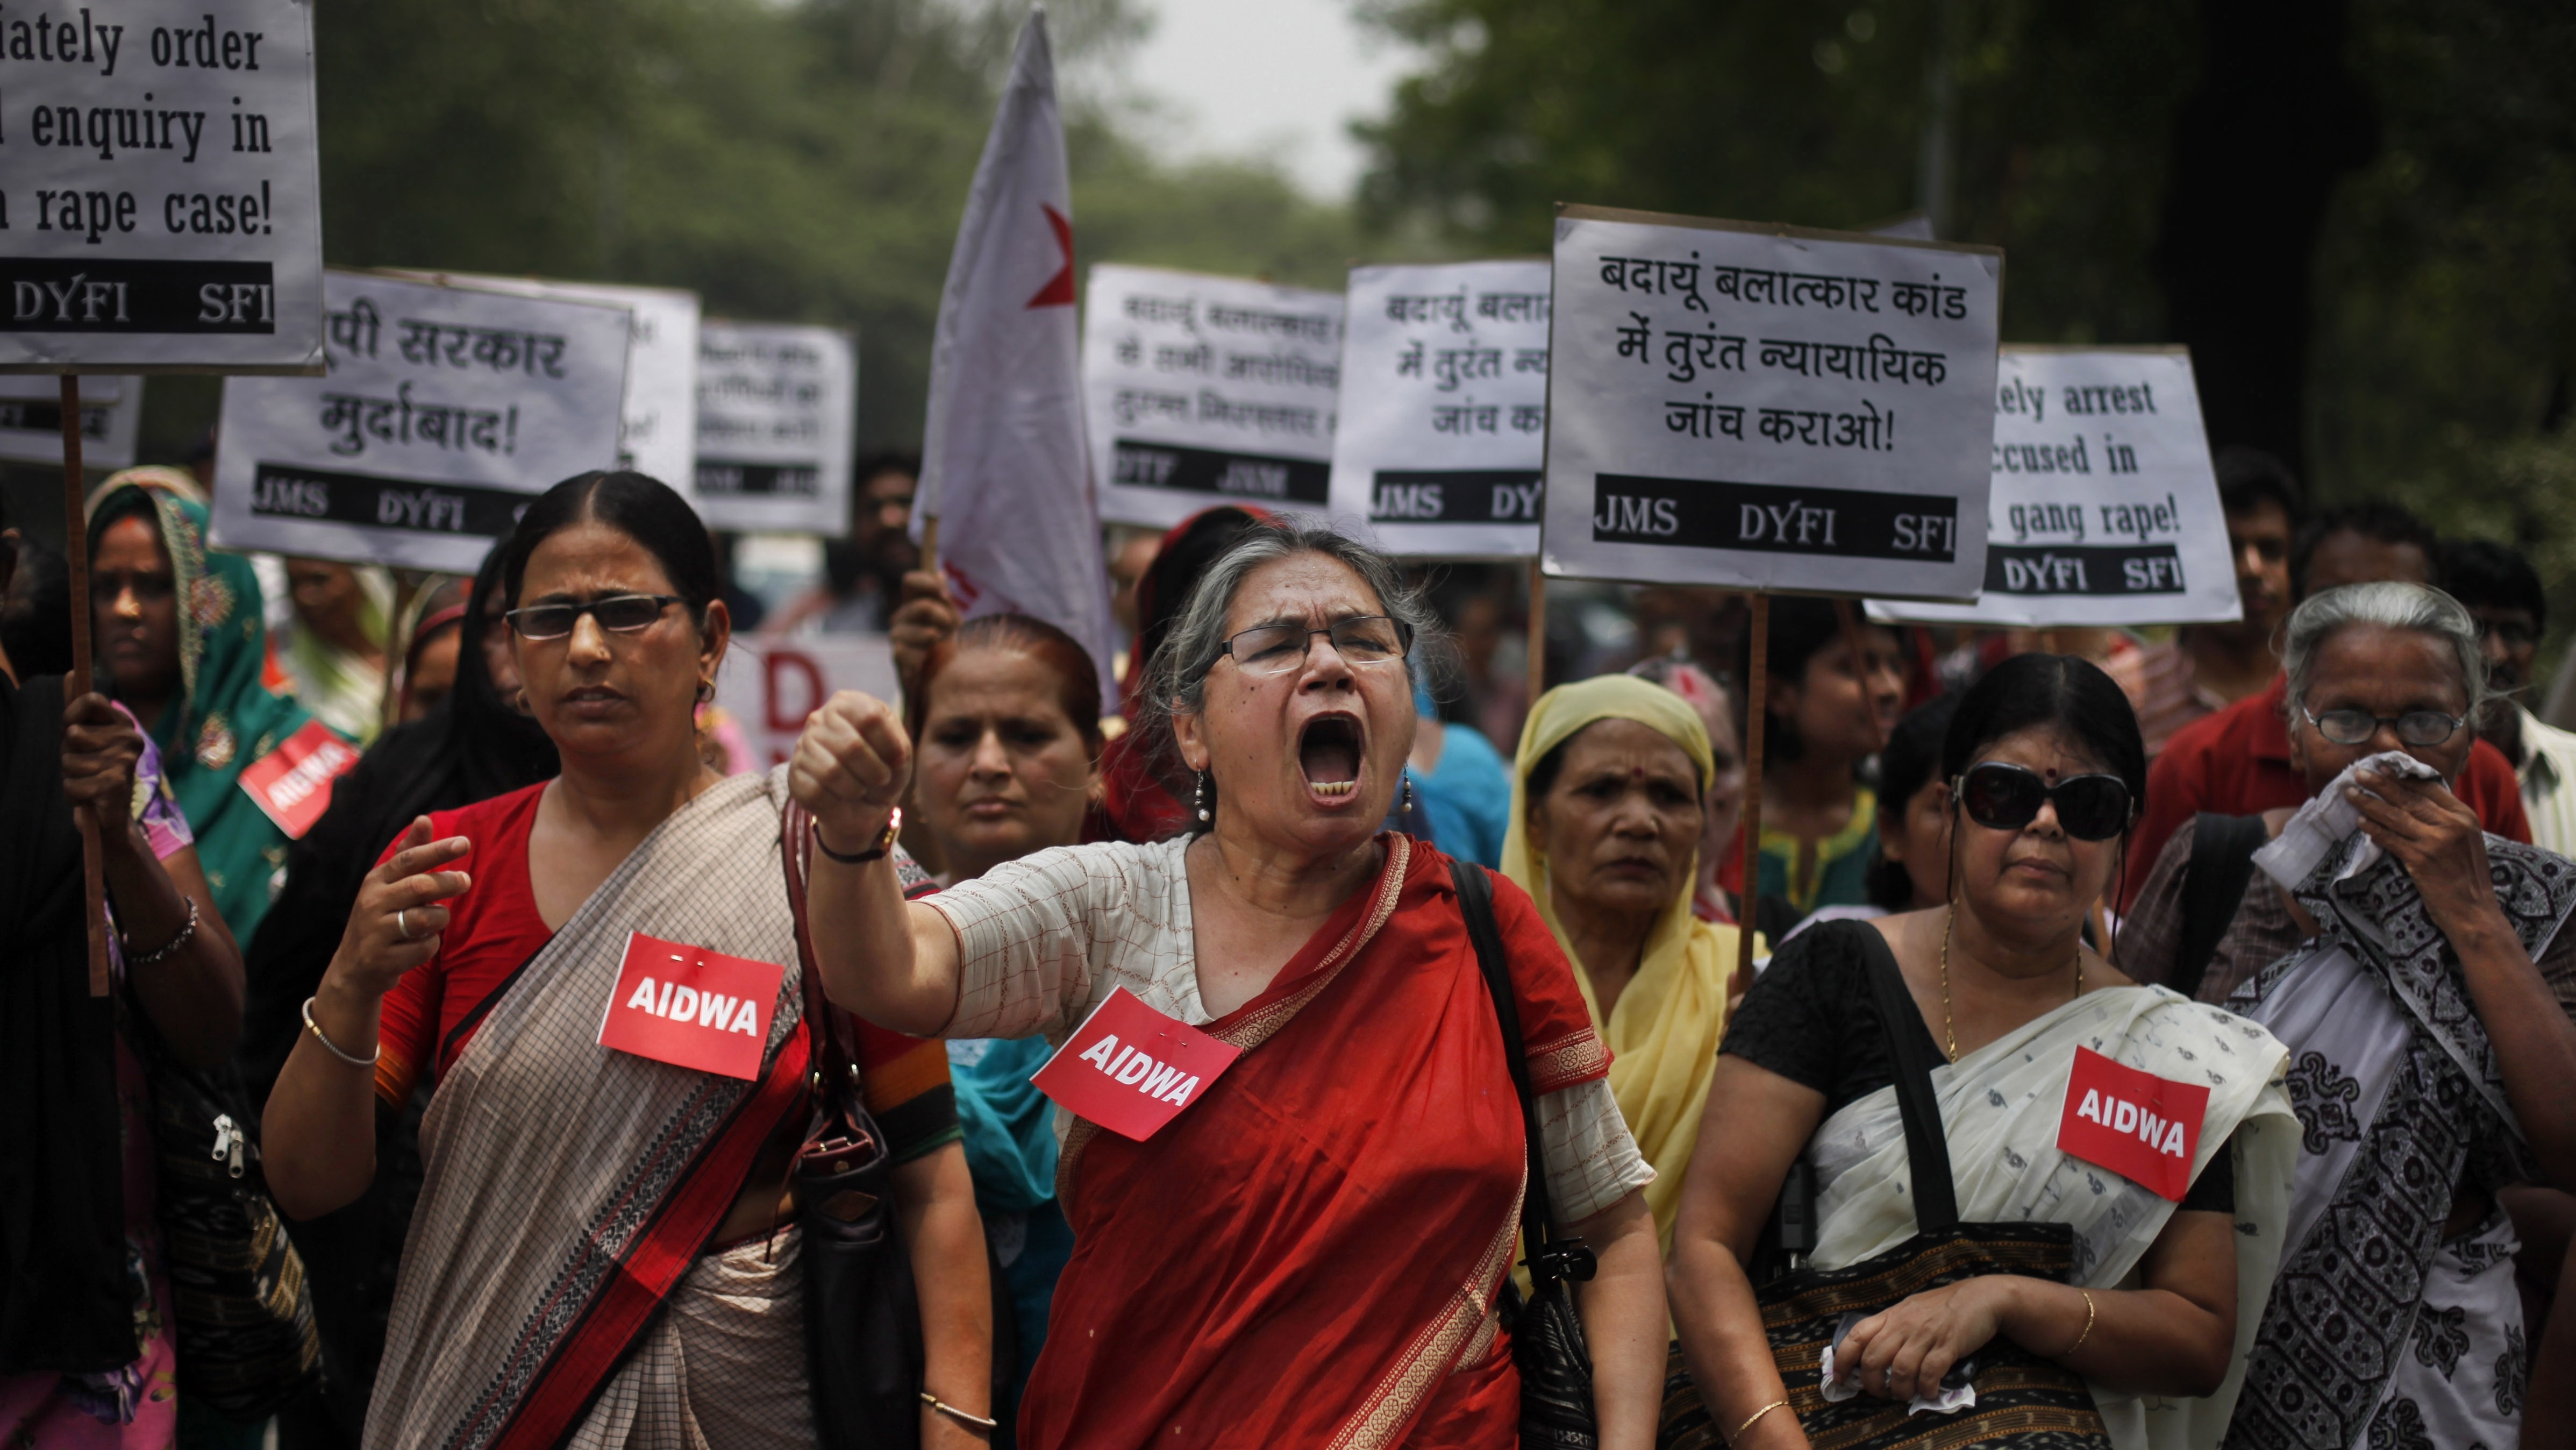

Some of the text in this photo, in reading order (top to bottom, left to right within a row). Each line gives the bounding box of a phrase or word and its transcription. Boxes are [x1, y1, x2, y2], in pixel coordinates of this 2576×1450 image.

[151, 14, 263, 70] order
[32, 93, 205, 162] enquiry
[232, 96, 271, 152] in
[36, 190, 135, 244] rape
[164, 180, 271, 234] case!
[13, 272, 273, 323] DYFI SFI
[1387, 284, 1472, 332] बदायूं
[1600, 251, 1967, 320] बदायूं बलात्कार कांड
[398, 318, 567, 378] सरकार
[1396, 338, 1424, 377] में
[1435, 338, 1502, 392] तुरंत
[1616, 312, 1947, 386] में तुरंत न्यायायिक
[320, 381, 518, 457] मुर्दाबाद!
[1432, 396, 1500, 435] जांच
[1665, 392, 1894, 451] जांच कराओ!
[1995, 379, 2158, 422] ely arrest
[2106, 435, 2138, 474] in
[253, 476, 328, 515] JMS
[377, 489, 465, 530] DYFI
[1371, 481, 1542, 518] JMS DY
[1595, 495, 1678, 536] JMS
[1739, 500, 1836, 546] DYFI
[1892, 514, 1955, 553] SFI
[2009, 493, 2181, 542] gang rape!
[2002, 553, 2183, 591] DYFI SFI
[626, 976, 757, 1037] AIDWA
[1079, 1034, 1200, 1106] AIDWA
[2077, 1088, 2183, 1158] AIDWA
